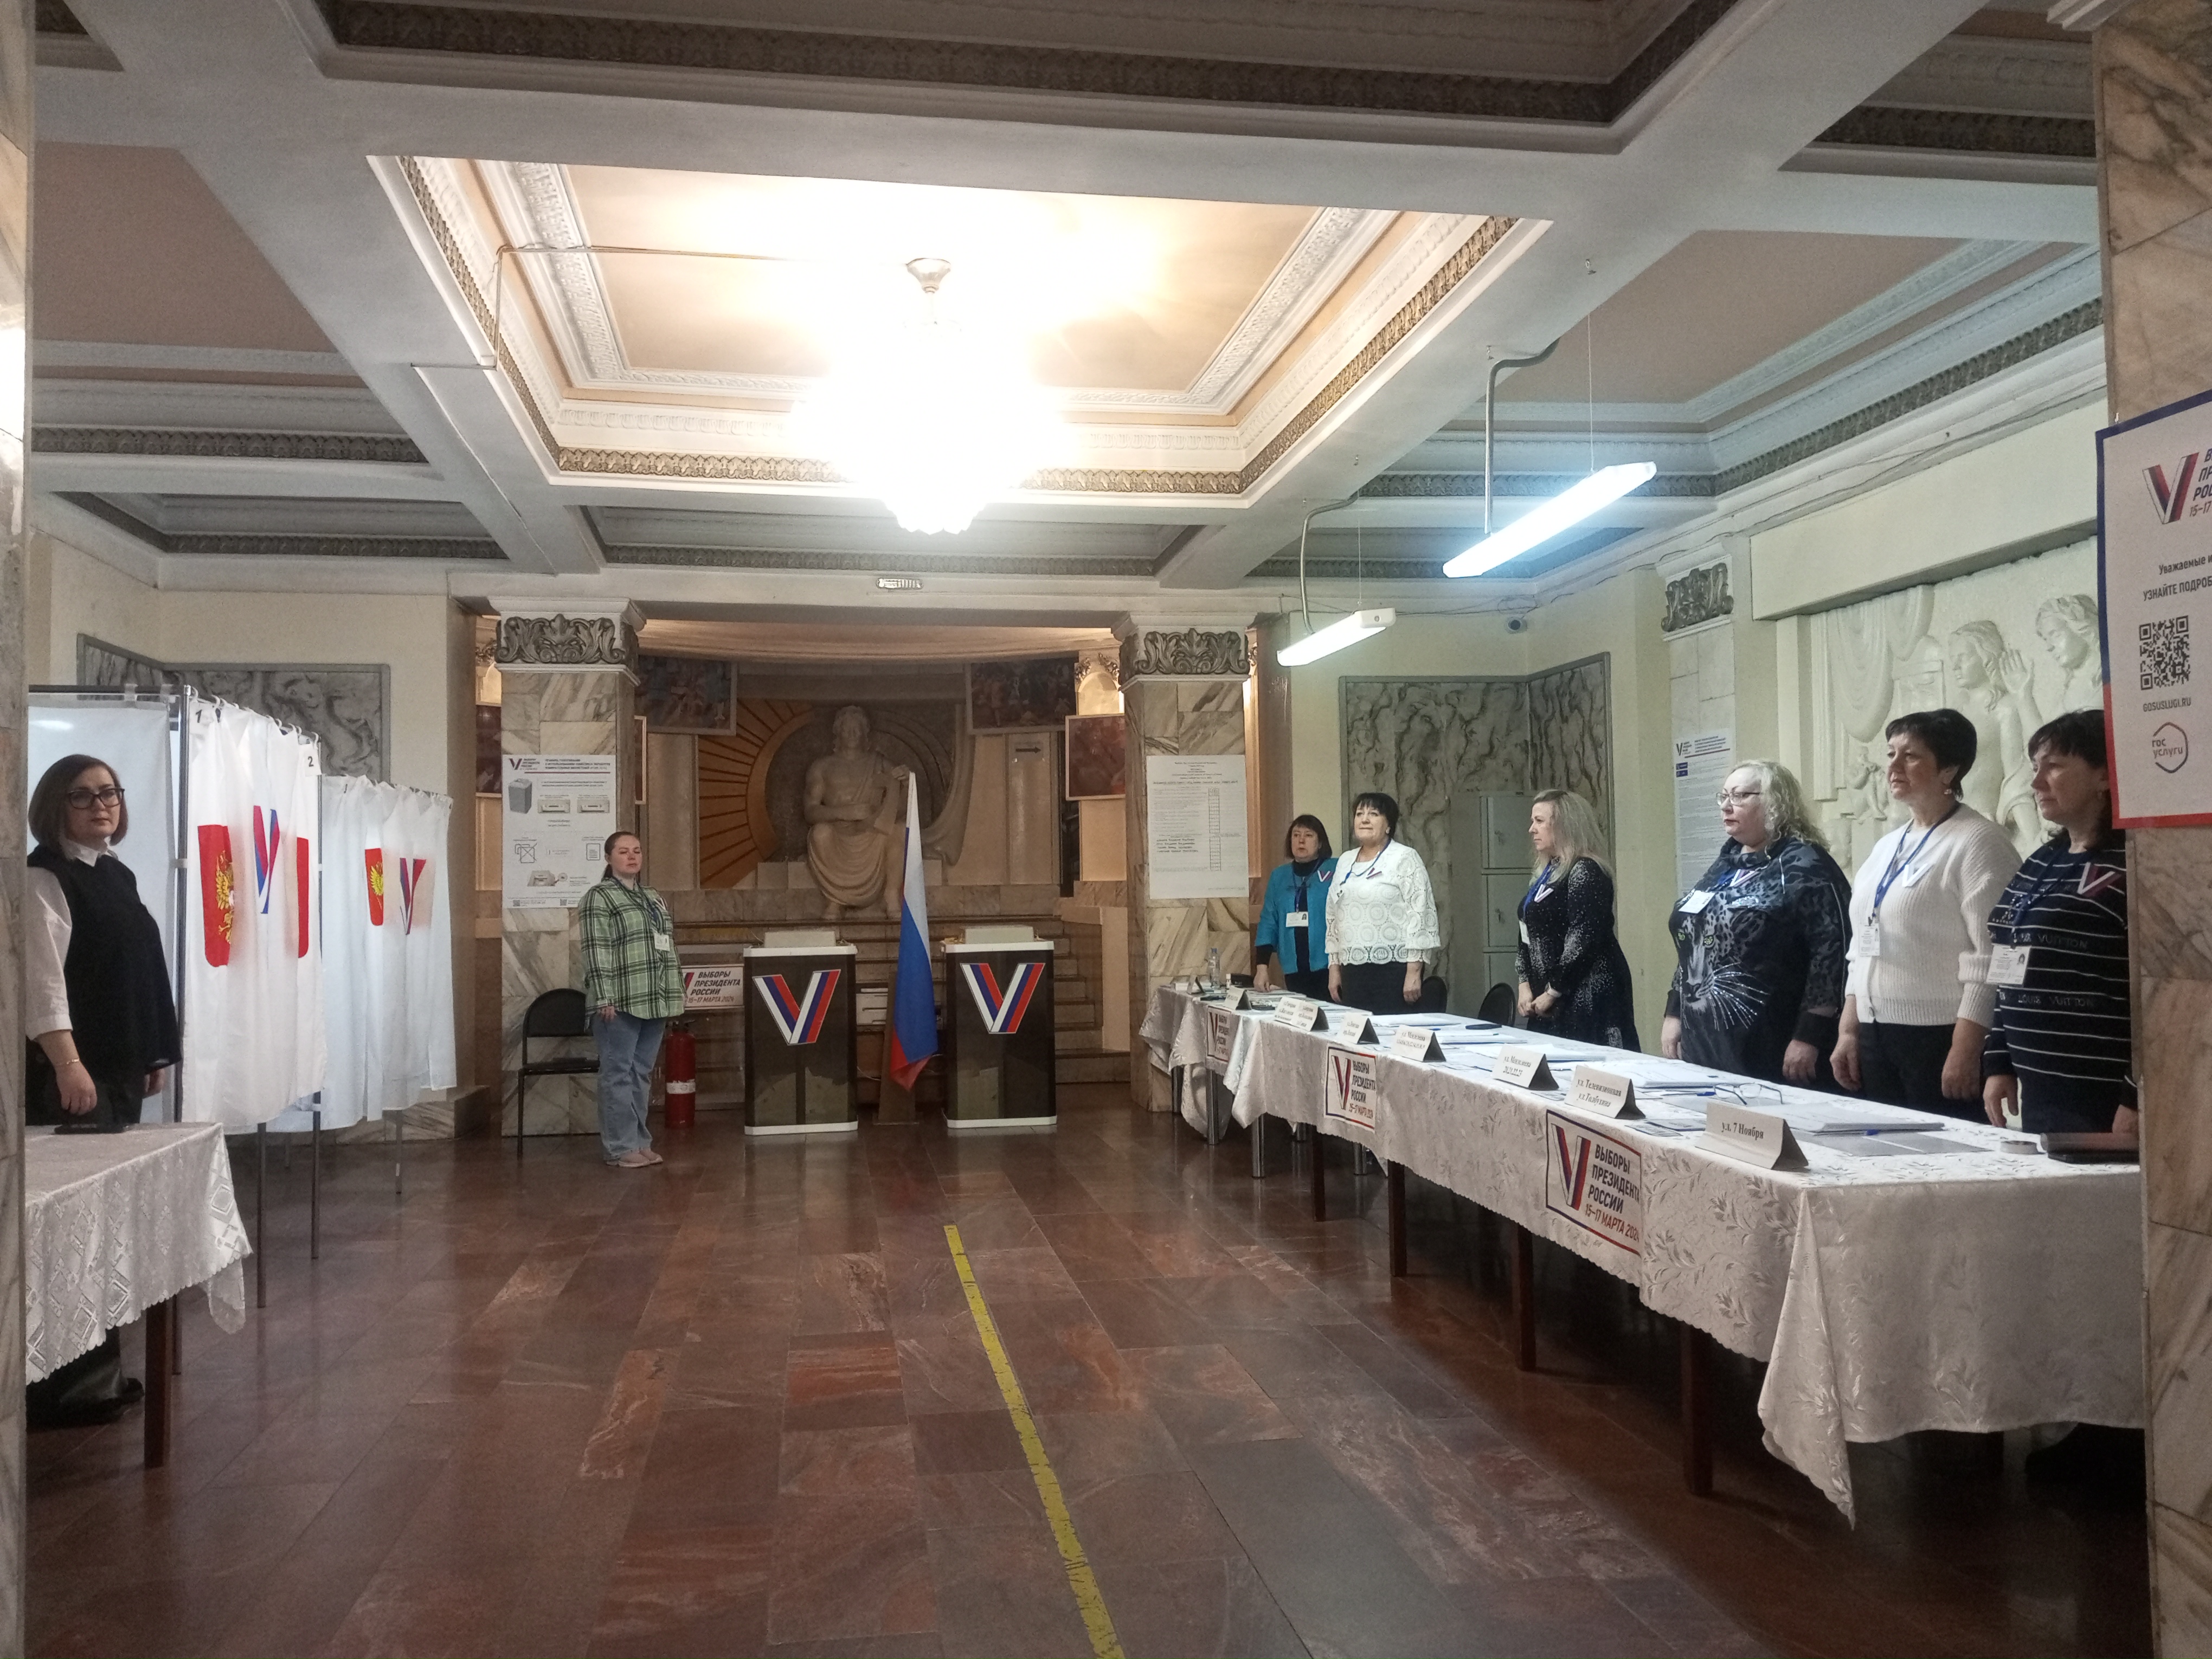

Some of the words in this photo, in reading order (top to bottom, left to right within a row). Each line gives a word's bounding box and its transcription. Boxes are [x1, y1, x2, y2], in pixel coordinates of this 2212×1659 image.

[2159, 556, 2206, 575] Уважаемые
[2143, 583, 2178, 601] УЗНАЙТЕ
[2143, 697, 2191, 712] GOSUSLUGI.RU
[195, 709, 202, 723] 1
[2152, 738, 2166, 747] гос
[307, 756, 314, 767] 2
[695, 979, 741, 987] ПРЕЗИДЕНТА
[1352, 1060, 1369, 1075] ВЫБОРЫ
[1351, 1075, 1376, 1092] ПРЕЗИДЕНТА
[1351, 1089, 1366, 1103] РОССИИ
[1721, 1122, 1731, 1133] ул.
[1733, 1122, 1738, 1133] 7
[1738, 1123, 1764, 1140] Ноября
[1594, 1144, 1630, 1174] ВЫБОРЫ
[1591, 1164, 1640, 1204] ПРЕЗИДЕНТА
[1588, 1184, 1624, 1214] РОССИИ
[1601, 1211, 1625, 1234] МАРТА
